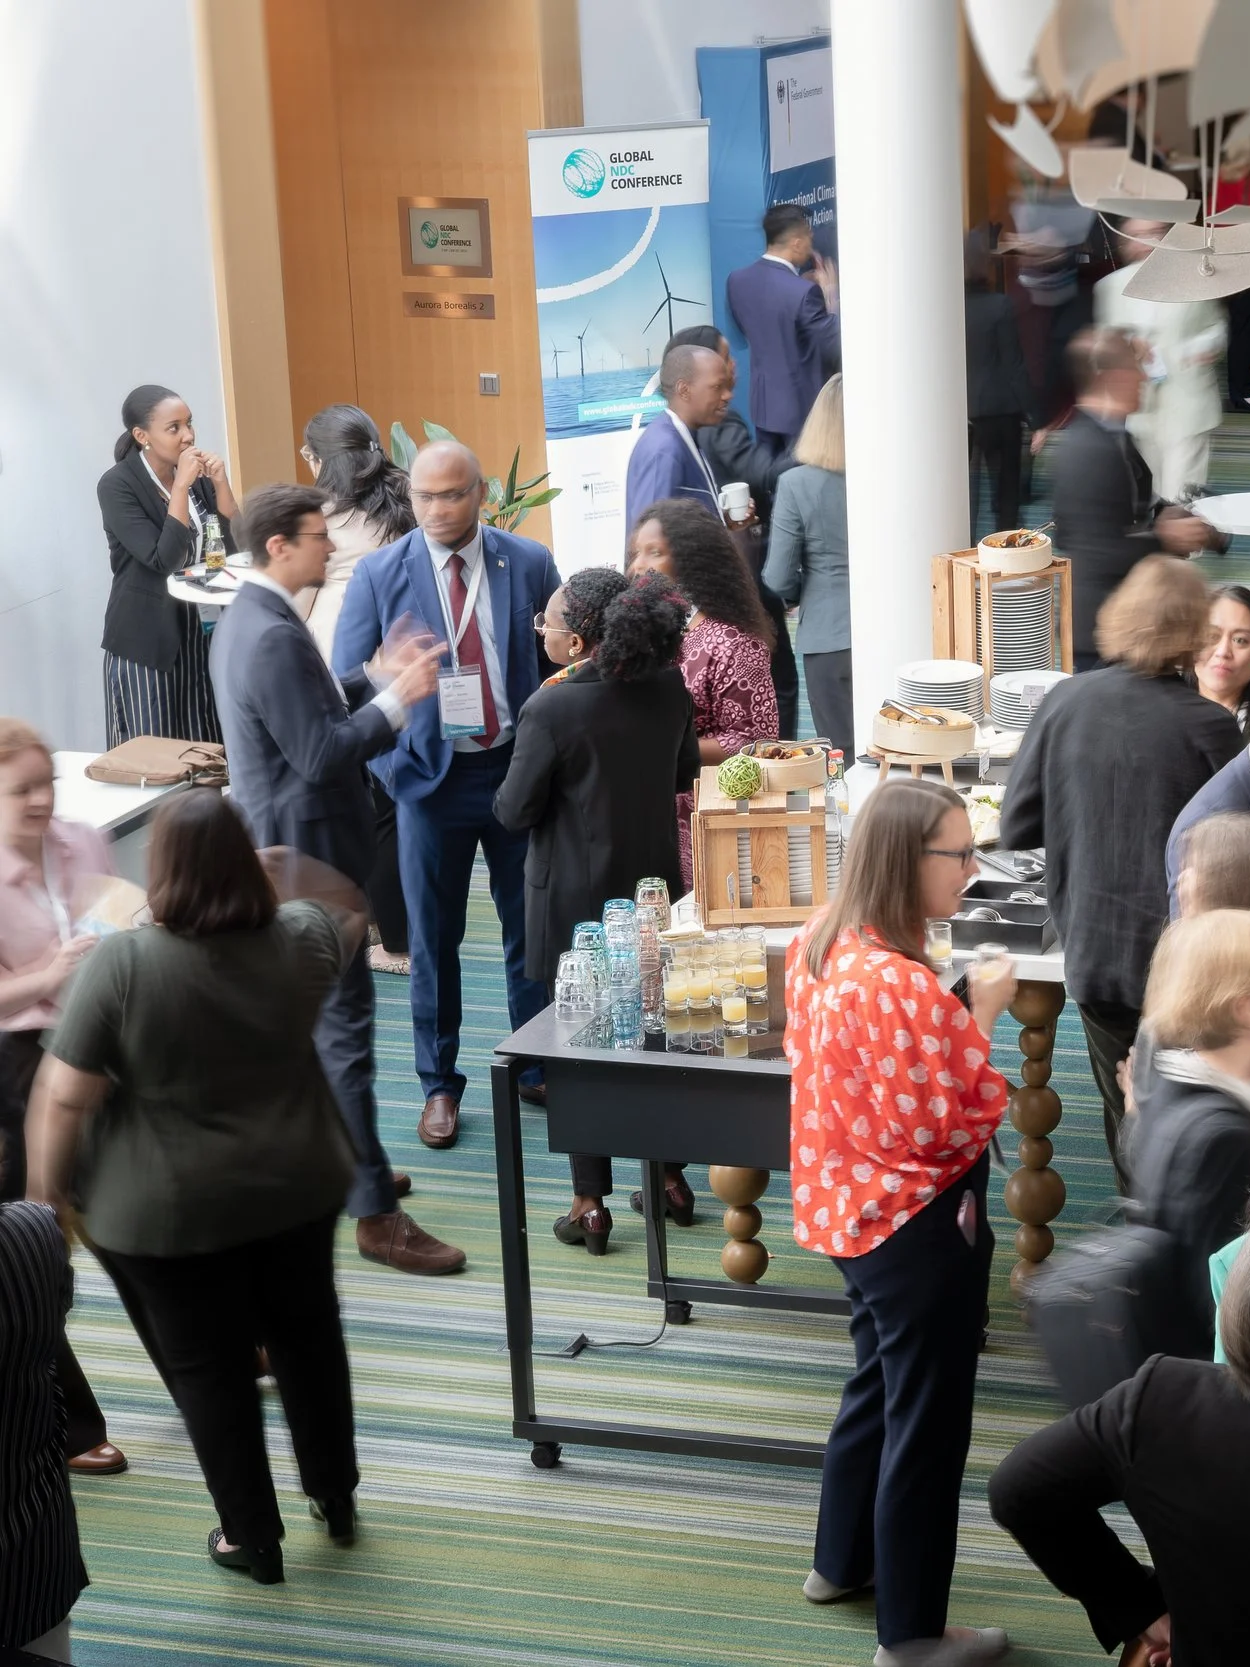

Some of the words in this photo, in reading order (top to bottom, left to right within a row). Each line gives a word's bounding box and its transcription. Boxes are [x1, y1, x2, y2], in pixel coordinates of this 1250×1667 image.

[609, 150, 654, 164] GLOBAL
[610, 165, 635, 177] NDC
[611, 174, 683, 190] CONFERENCE
[817, 185, 838, 202] Clima
[813, 208, 834, 226] Action
[414, 300, 442, 309] Aurora
[444, 301, 477, 310] Borealis
[479, 302, 485, 311] 2
